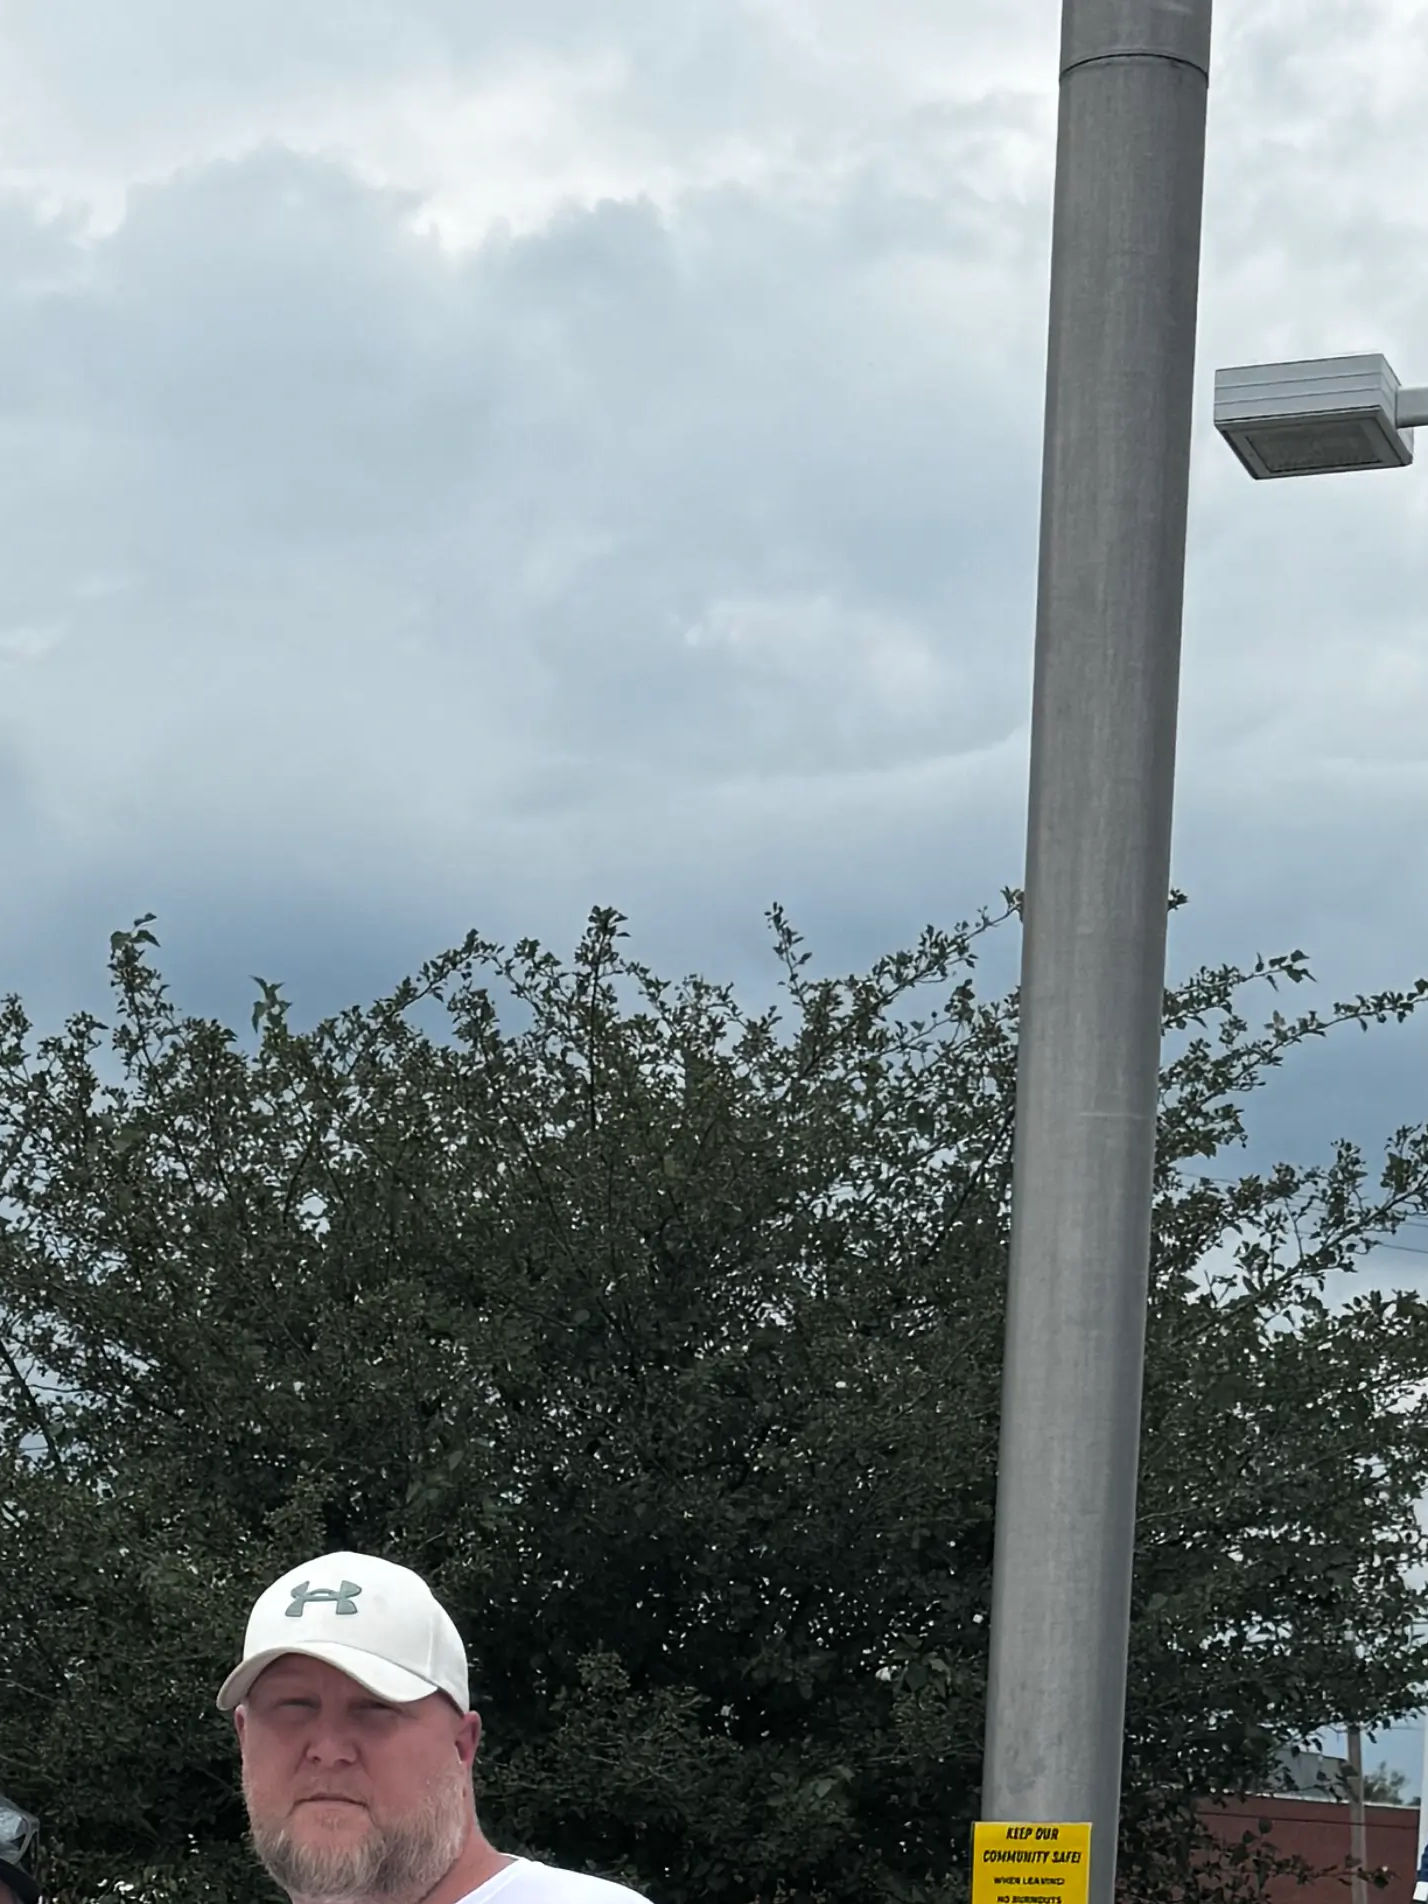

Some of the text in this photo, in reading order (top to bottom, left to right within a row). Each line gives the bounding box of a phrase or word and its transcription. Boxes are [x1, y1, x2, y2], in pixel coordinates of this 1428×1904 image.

[1006, 1827, 1059, 1841] KEEP OUR
[983, 1850, 1049, 1864] COMMUNITY
[994, 1876, 1021, 1885] WHEN
[997, 1895, 1062, 1904] NO BURNOUTS
